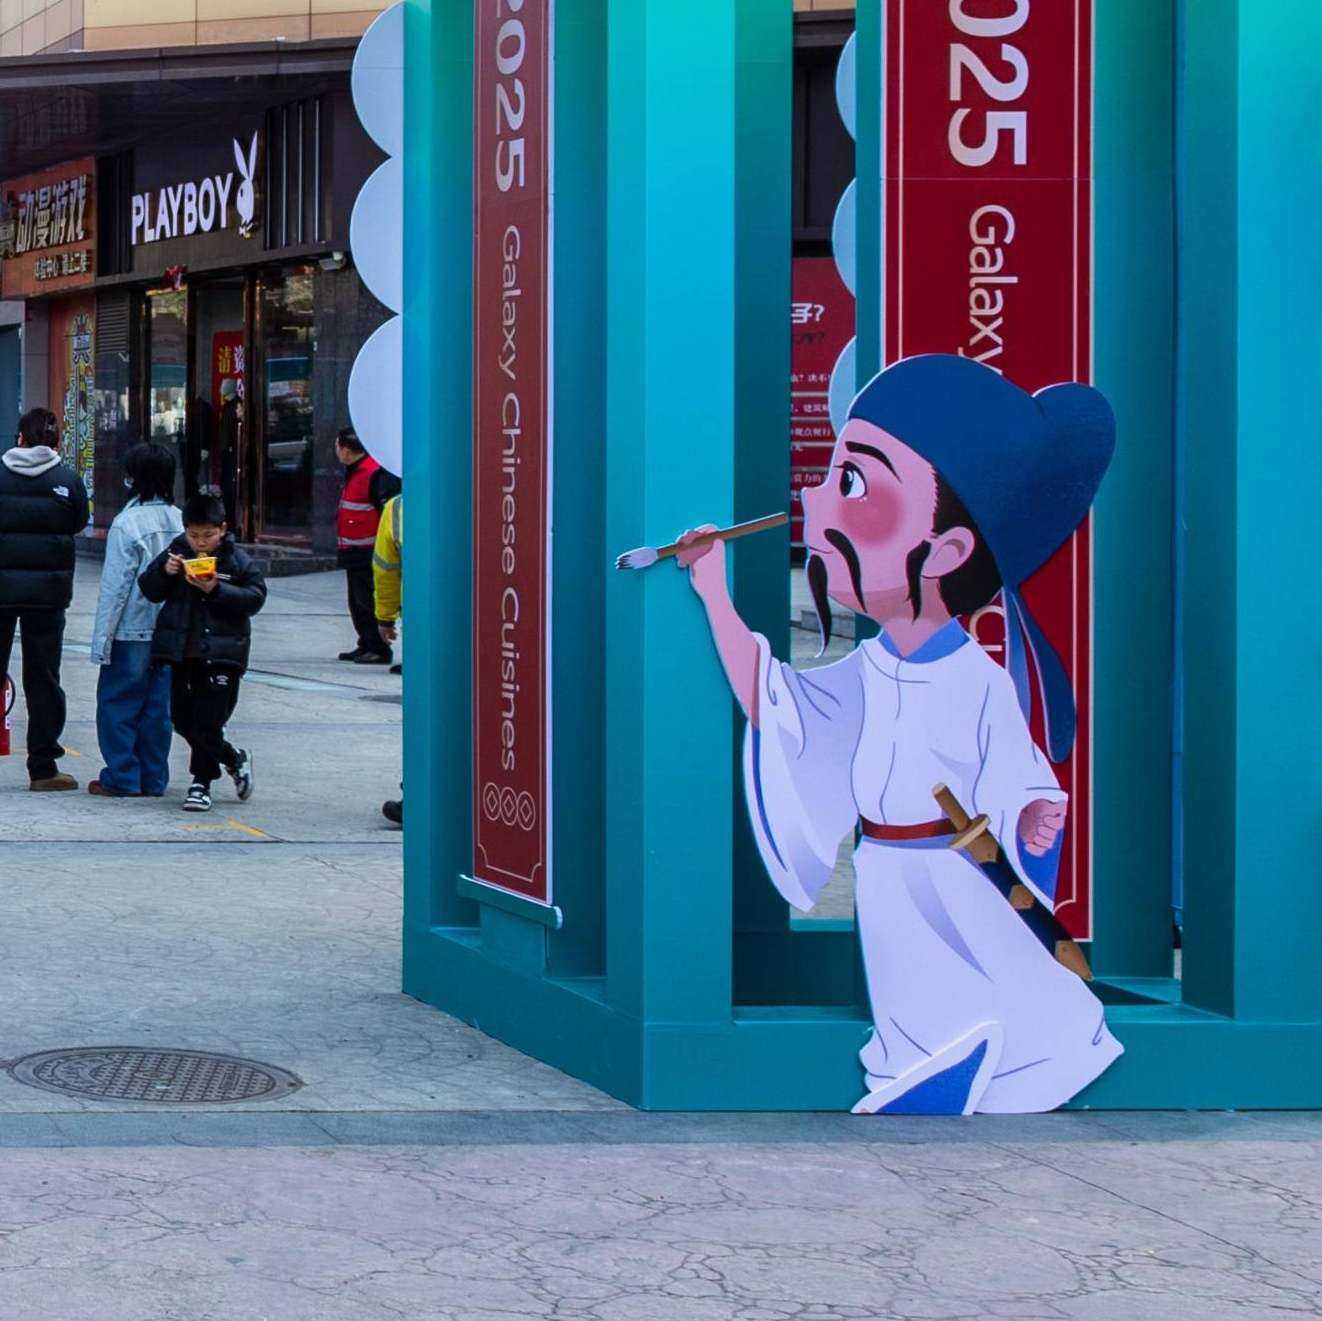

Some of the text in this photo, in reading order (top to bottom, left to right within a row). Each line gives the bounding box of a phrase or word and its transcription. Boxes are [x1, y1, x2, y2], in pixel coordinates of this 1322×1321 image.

[131, 172, 234, 246] PLAYBOY
[498, 224, 522, 381] Galaxy
[501, 392, 522, 575] Chinese
[501, 586, 521, 771] Cuisines
